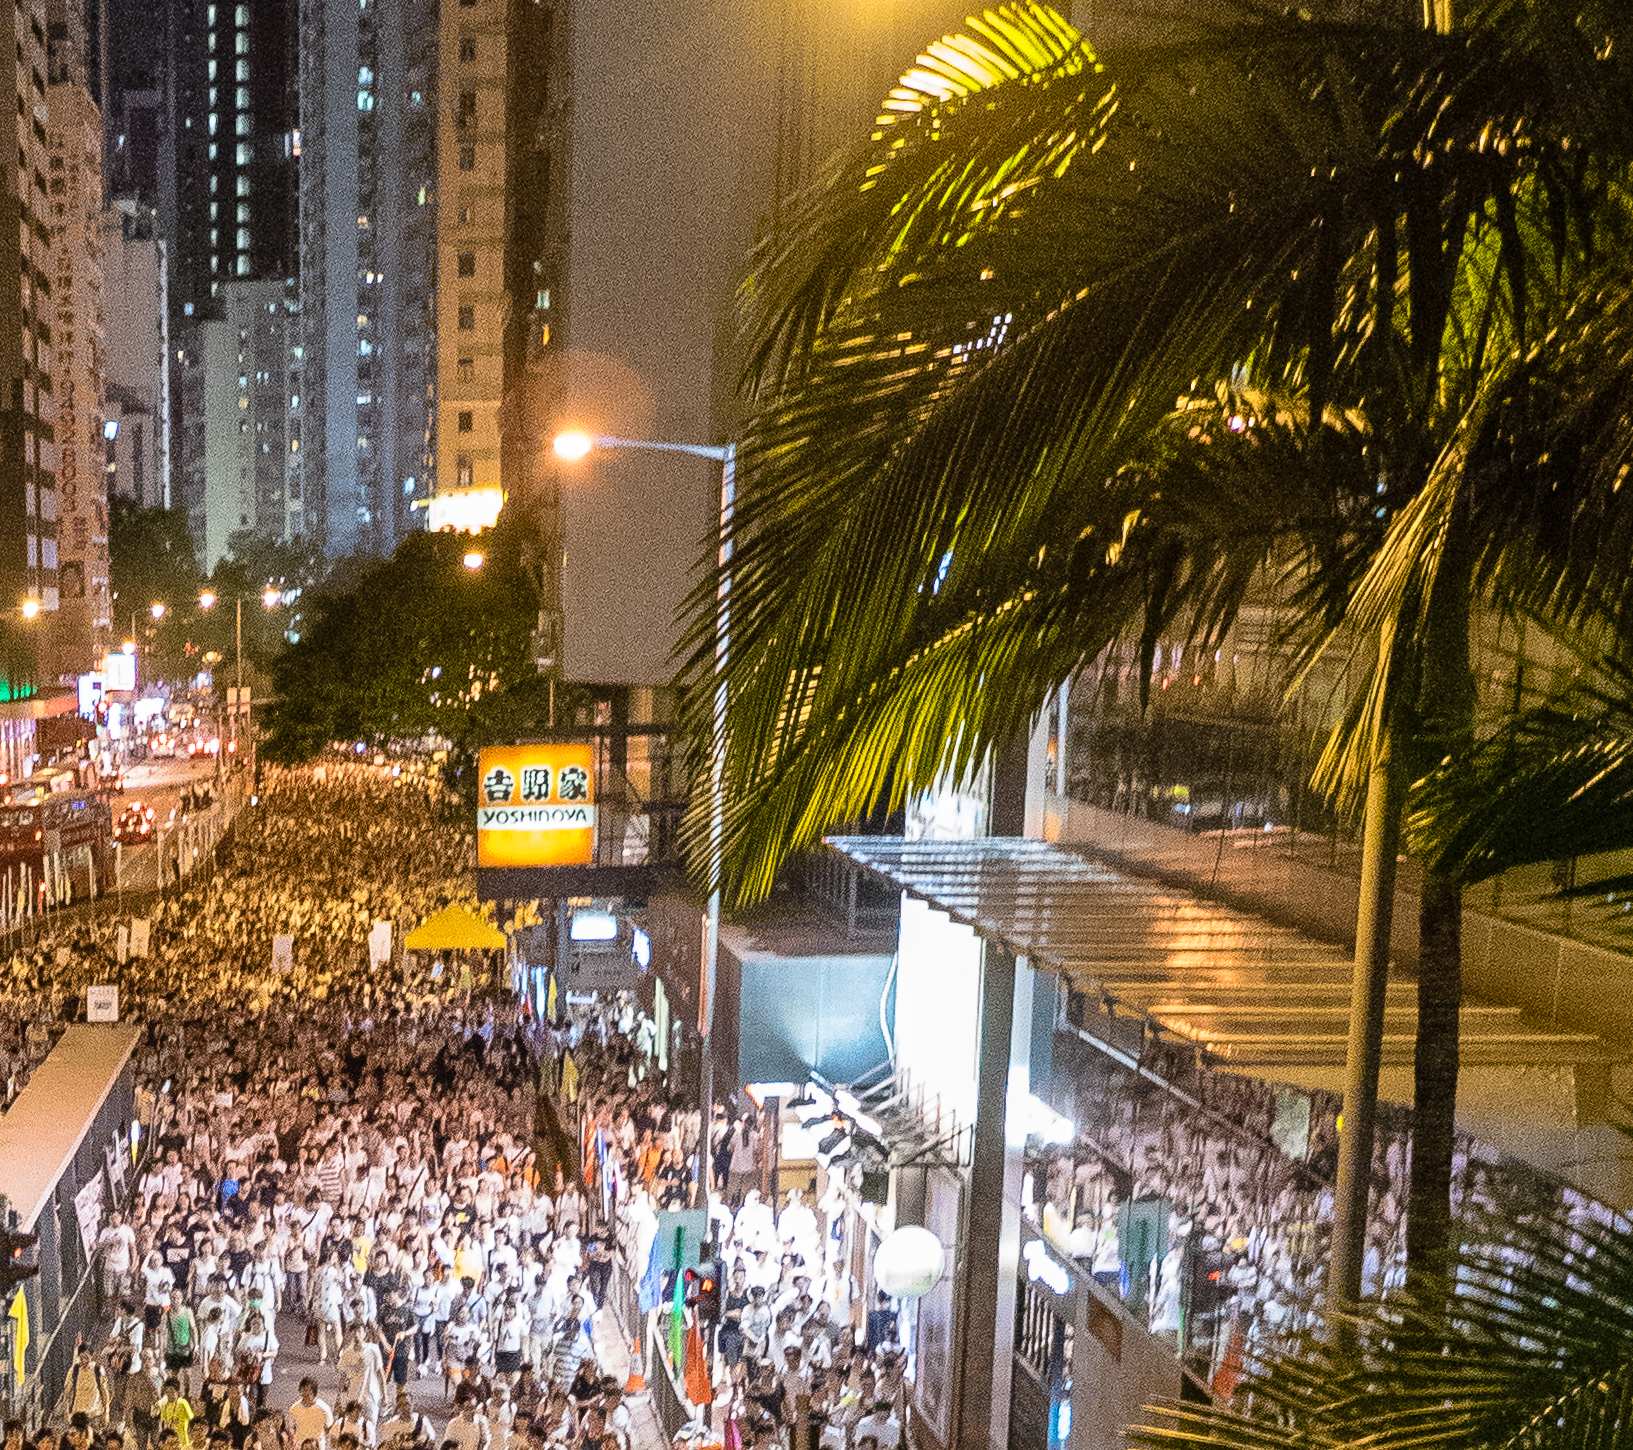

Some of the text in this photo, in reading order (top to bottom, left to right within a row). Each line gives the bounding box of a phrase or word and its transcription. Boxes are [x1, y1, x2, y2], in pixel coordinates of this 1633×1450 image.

[484, 767, 588, 802] 吉野家
[483, 808, 587, 826] YOSHINOYA
